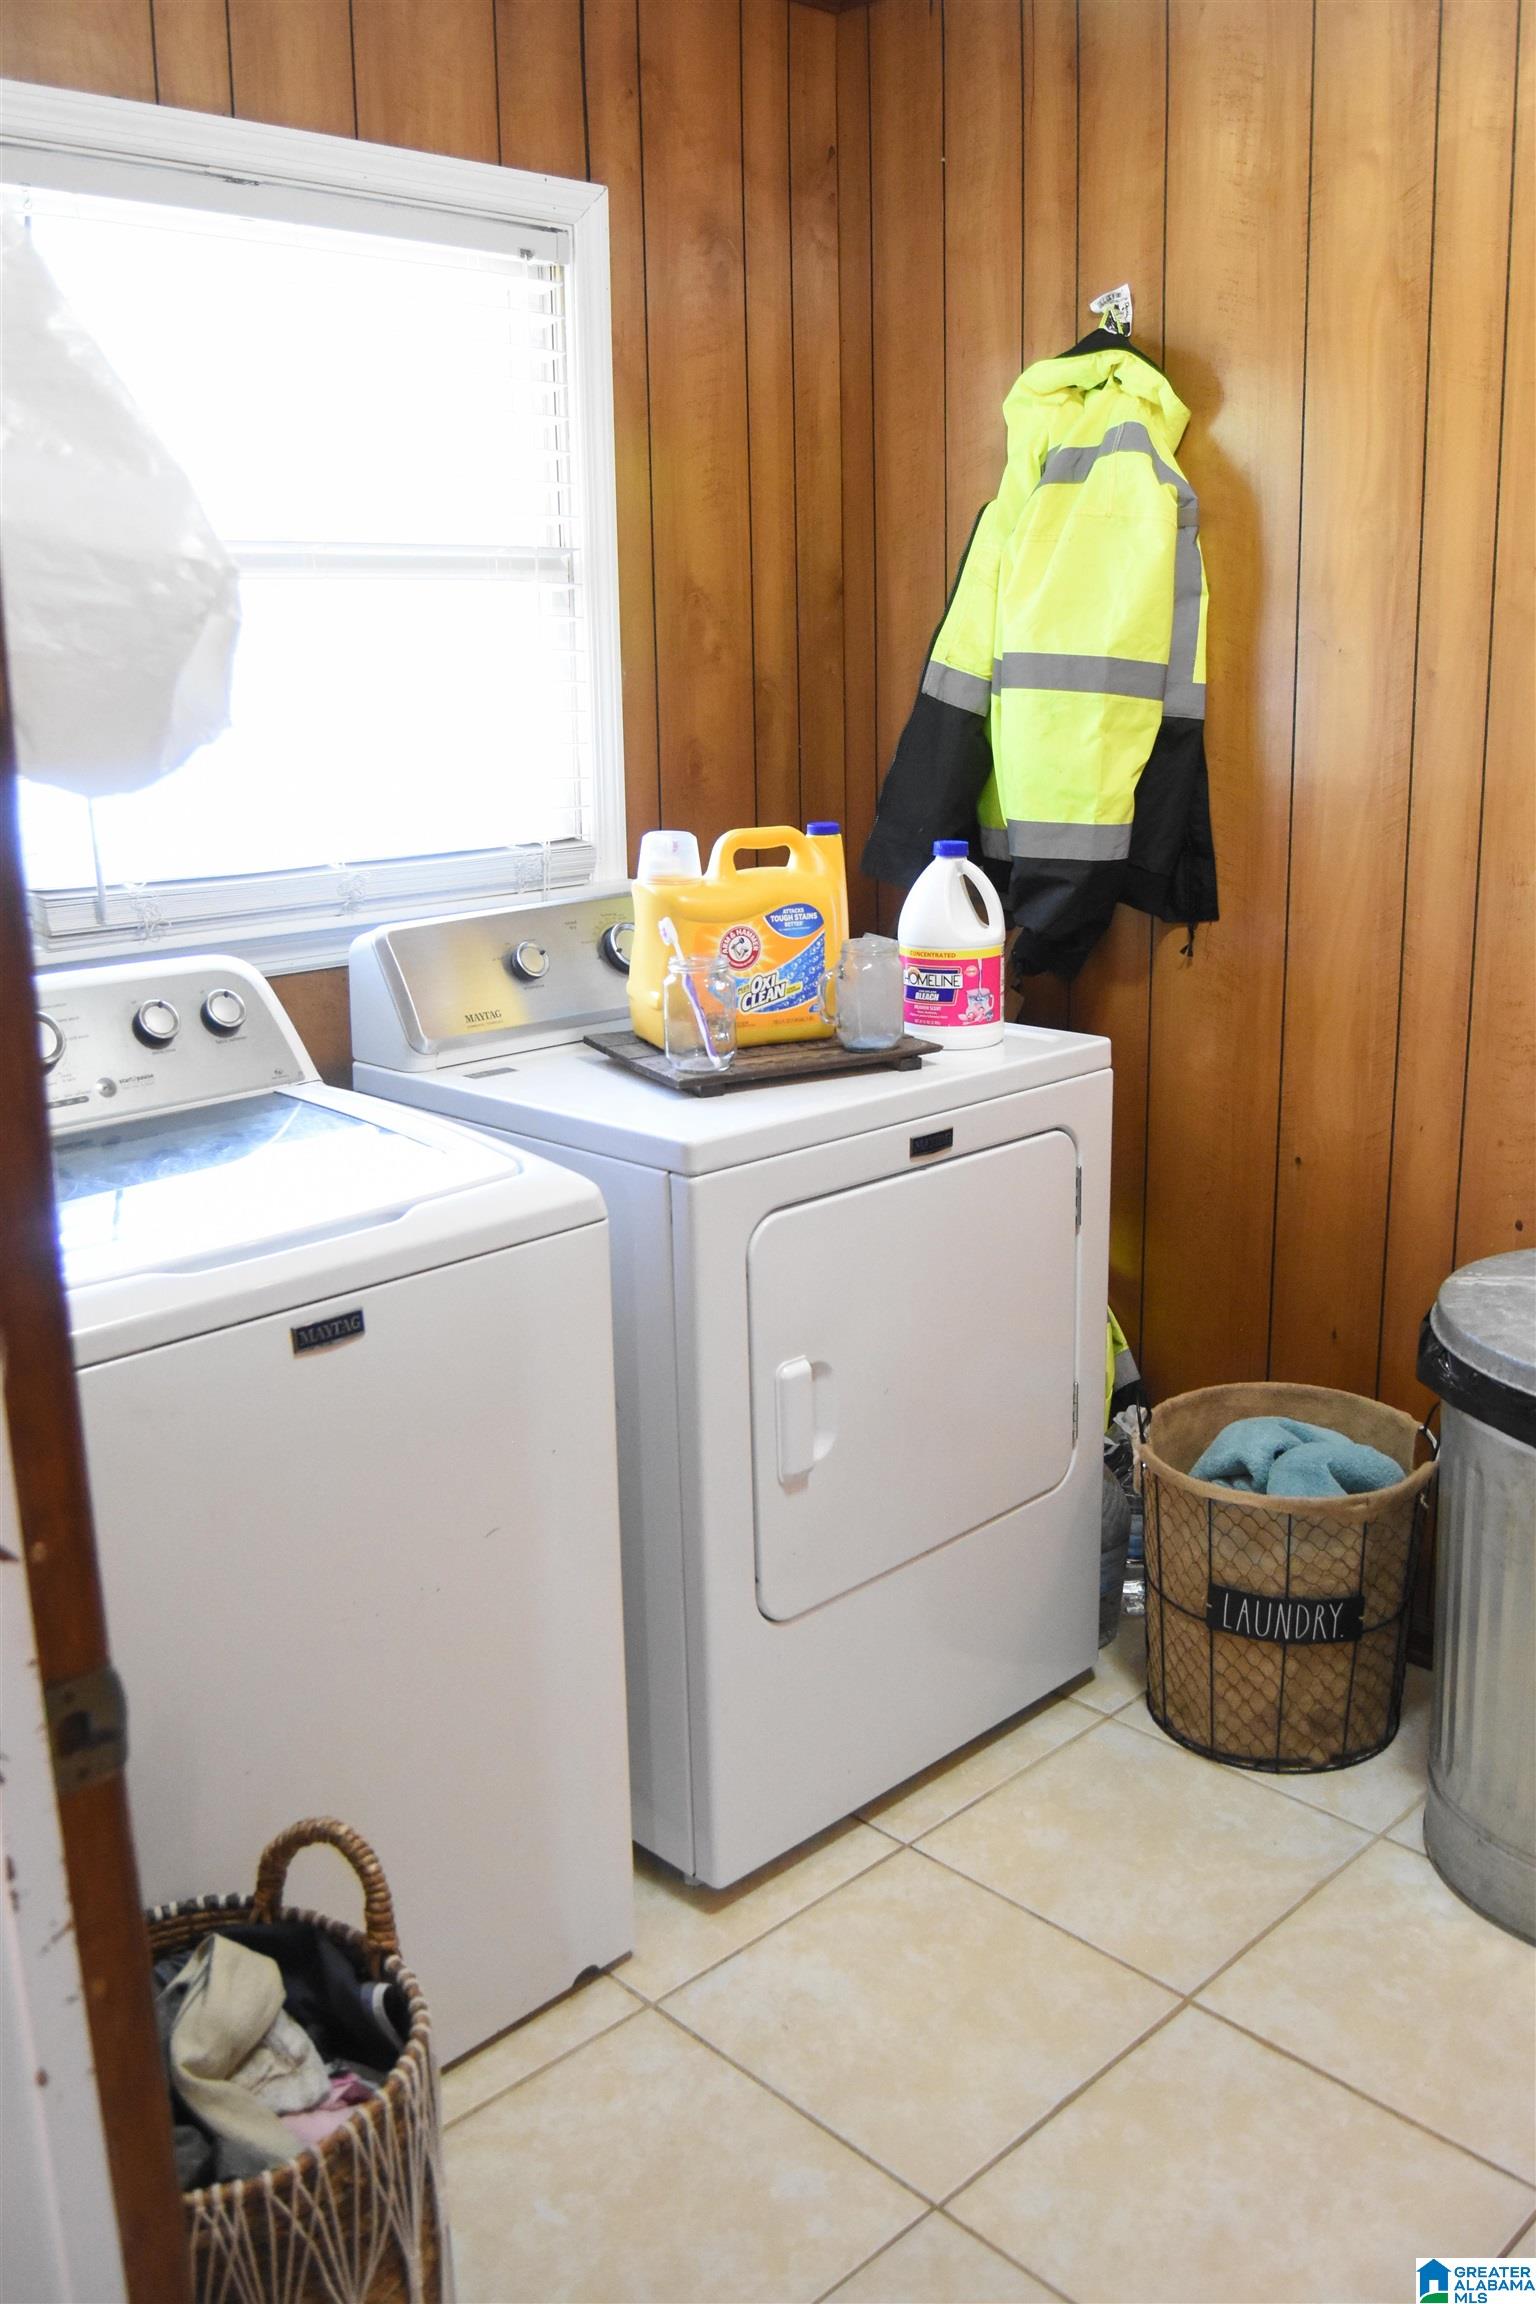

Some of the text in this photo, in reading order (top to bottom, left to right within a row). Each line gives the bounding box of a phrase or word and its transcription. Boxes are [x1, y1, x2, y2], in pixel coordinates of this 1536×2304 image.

[770, 912, 818, 923] TOUGH STAINS
[721, 936, 733, 954] ARM
[736, 928, 759, 951] HAMMER
[751, 974, 777, 993] OXI
[741, 982, 787, 1012] CLEAN
[914, 992, 939, 1001] BLEACH
[464, 1009, 502, 1023] MAYTAG
[299, 1314, 361, 1344] MAYTAG
